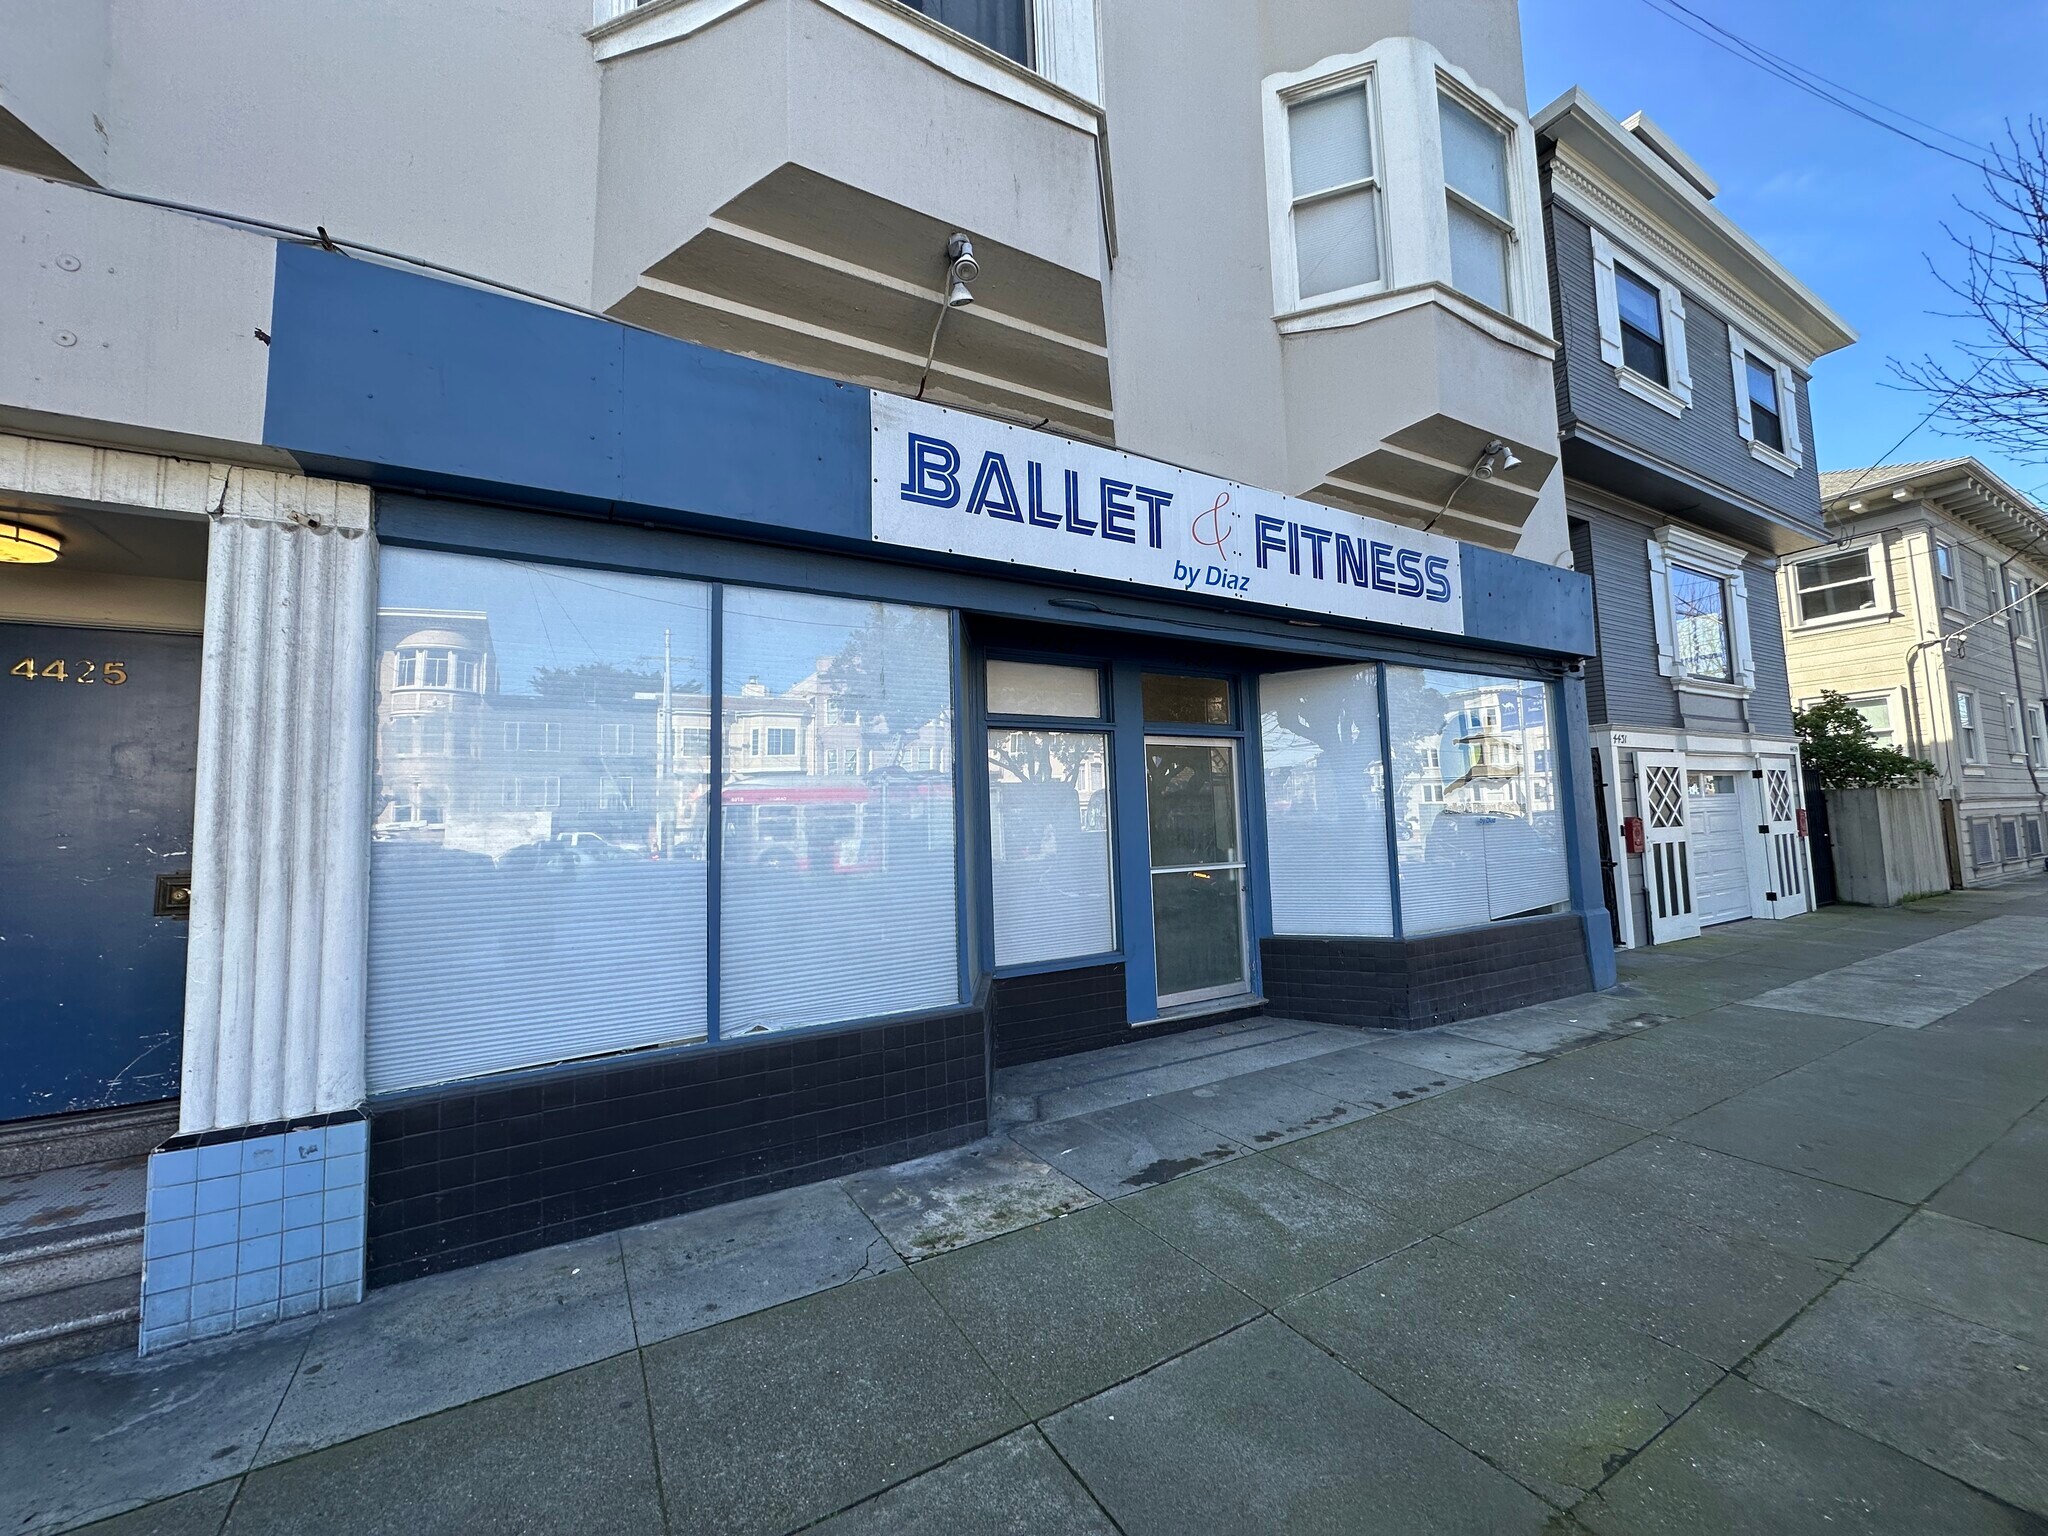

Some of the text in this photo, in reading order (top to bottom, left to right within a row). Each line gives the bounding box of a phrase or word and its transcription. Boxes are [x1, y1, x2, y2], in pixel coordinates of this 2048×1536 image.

[900, 431, 1453, 604] BALLET & FITNESS
[1173, 559, 1250, 592] by Diaz
[9, 656, 128, 687] 4425
